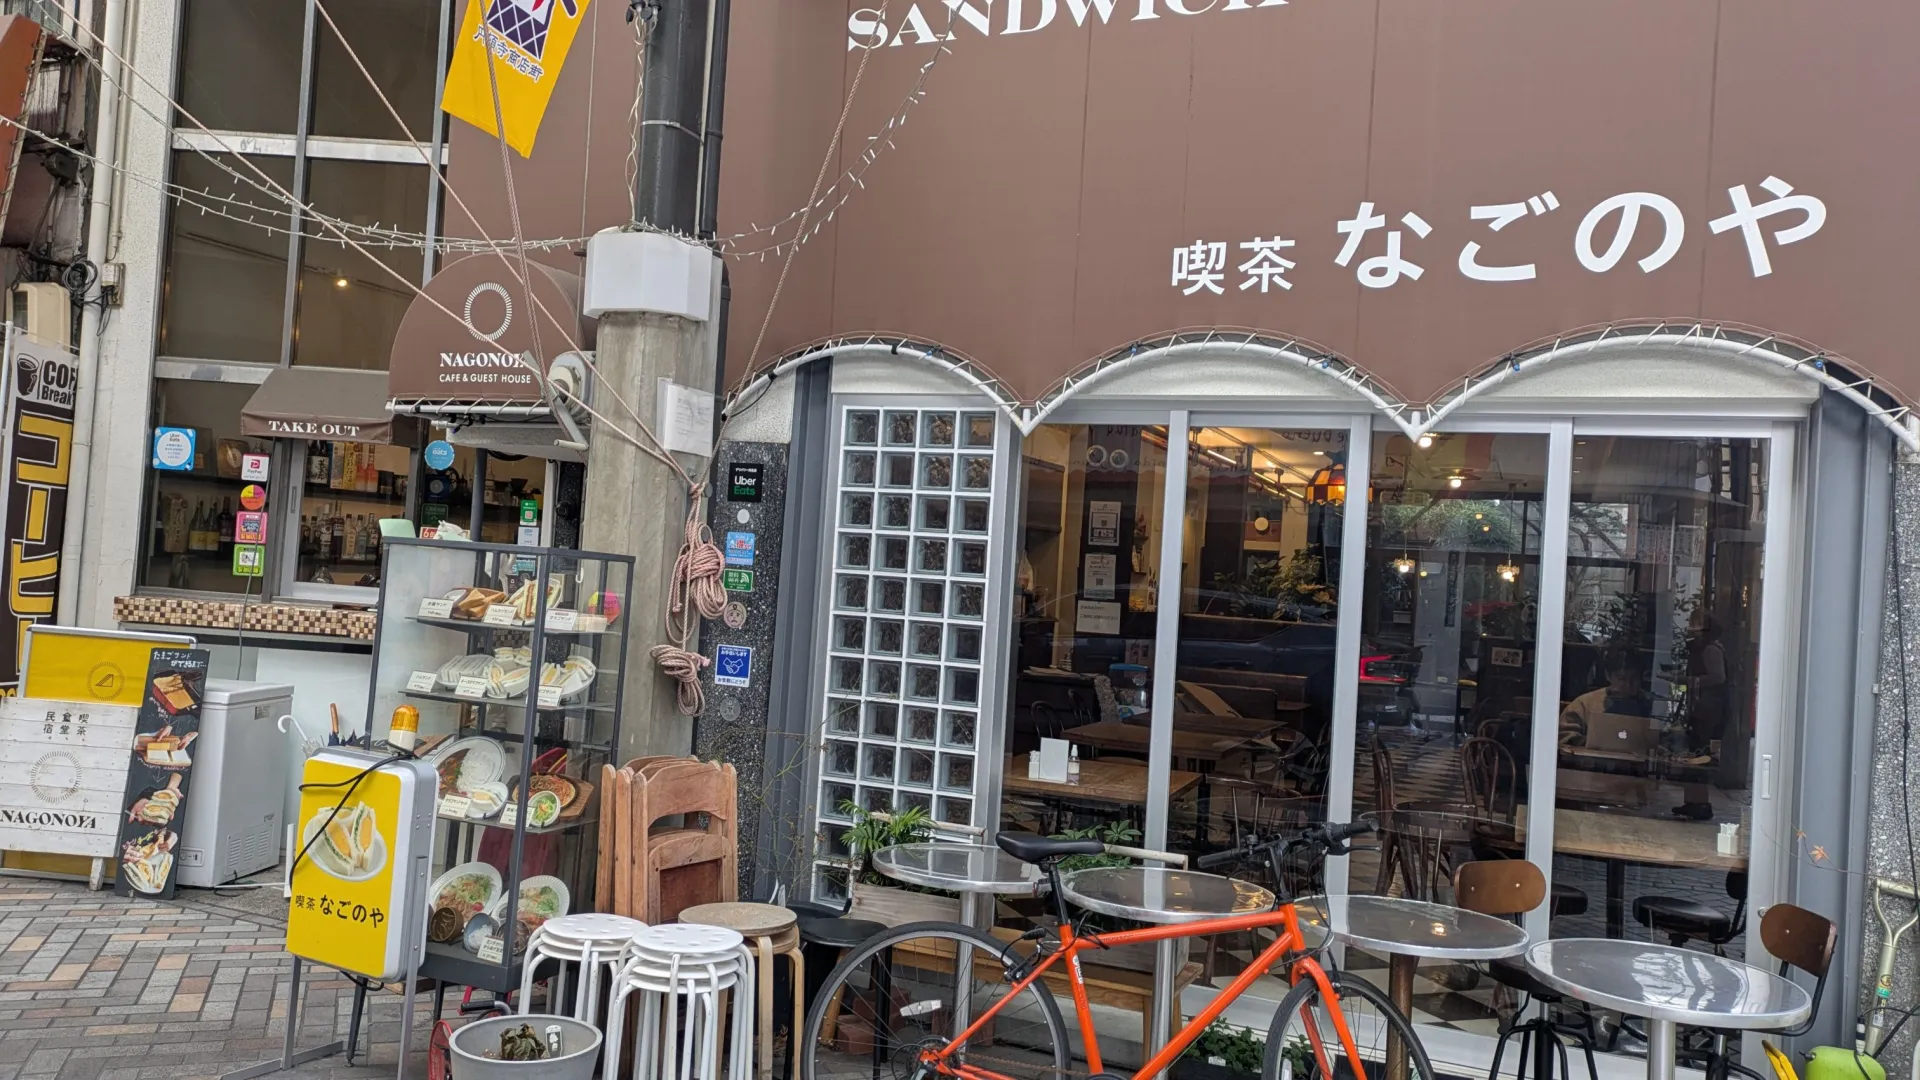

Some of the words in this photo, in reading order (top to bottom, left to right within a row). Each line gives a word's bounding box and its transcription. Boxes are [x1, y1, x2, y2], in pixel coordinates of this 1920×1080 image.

[1171, 235, 1296, 296] 喫茶
[1334, 175, 1827, 288] なごのや
[439, 373, 461, 383] CAFE
[462, 373, 469, 382] &
[470, 373, 499, 383] GUEST
[501, 374, 531, 384] HOUSE
[268, 420, 317, 434] TAKE
[321, 424, 360, 437] OUT
[734, 475, 757, 486] Uber
[733, 485, 756, 496] Eats
[153, 650, 192, 661] たまごサンド
[0, 809, 96, 829] NAGONOYA
[295, 894, 316, 911] 喫茶
[319, 894, 385, 929] なごのや
